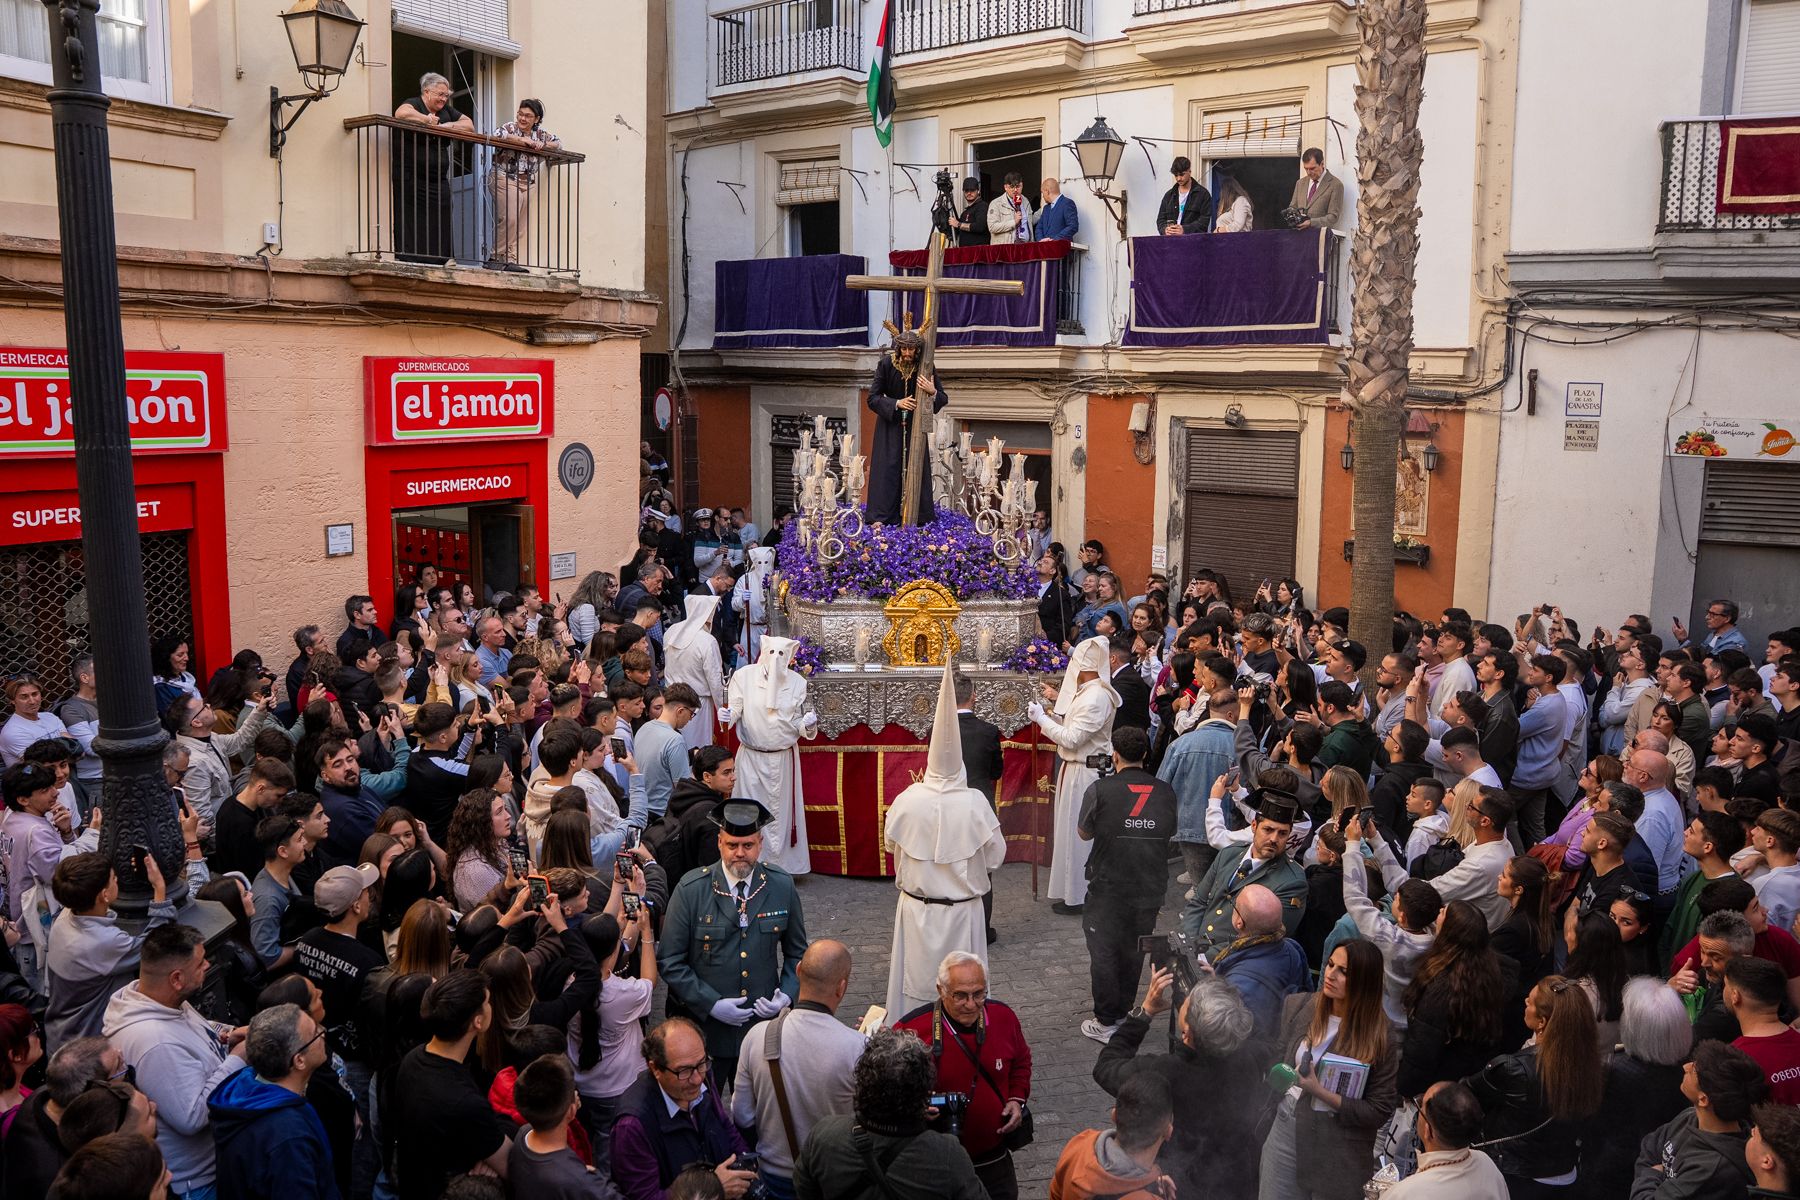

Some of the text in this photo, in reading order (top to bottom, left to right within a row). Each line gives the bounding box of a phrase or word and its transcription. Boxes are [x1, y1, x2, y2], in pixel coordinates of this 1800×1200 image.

[398, 362, 470, 372] SUPERMERCADOS
[43, 378, 196, 436] jón
[403, 379, 534, 427] el jamón
[1568, 402, 1600, 410] CANASTAS
[569, 463, 585, 479] ifa
[407, 475, 511, 495] SUPERMERCADO
[1127, 783, 1154, 817] 7
[1125, 818, 1156, 829] siete
[299, 954, 316, 968] NOT
[315, 961, 338, 979] LOVE
[319, 950, 359, 978] RATHER
